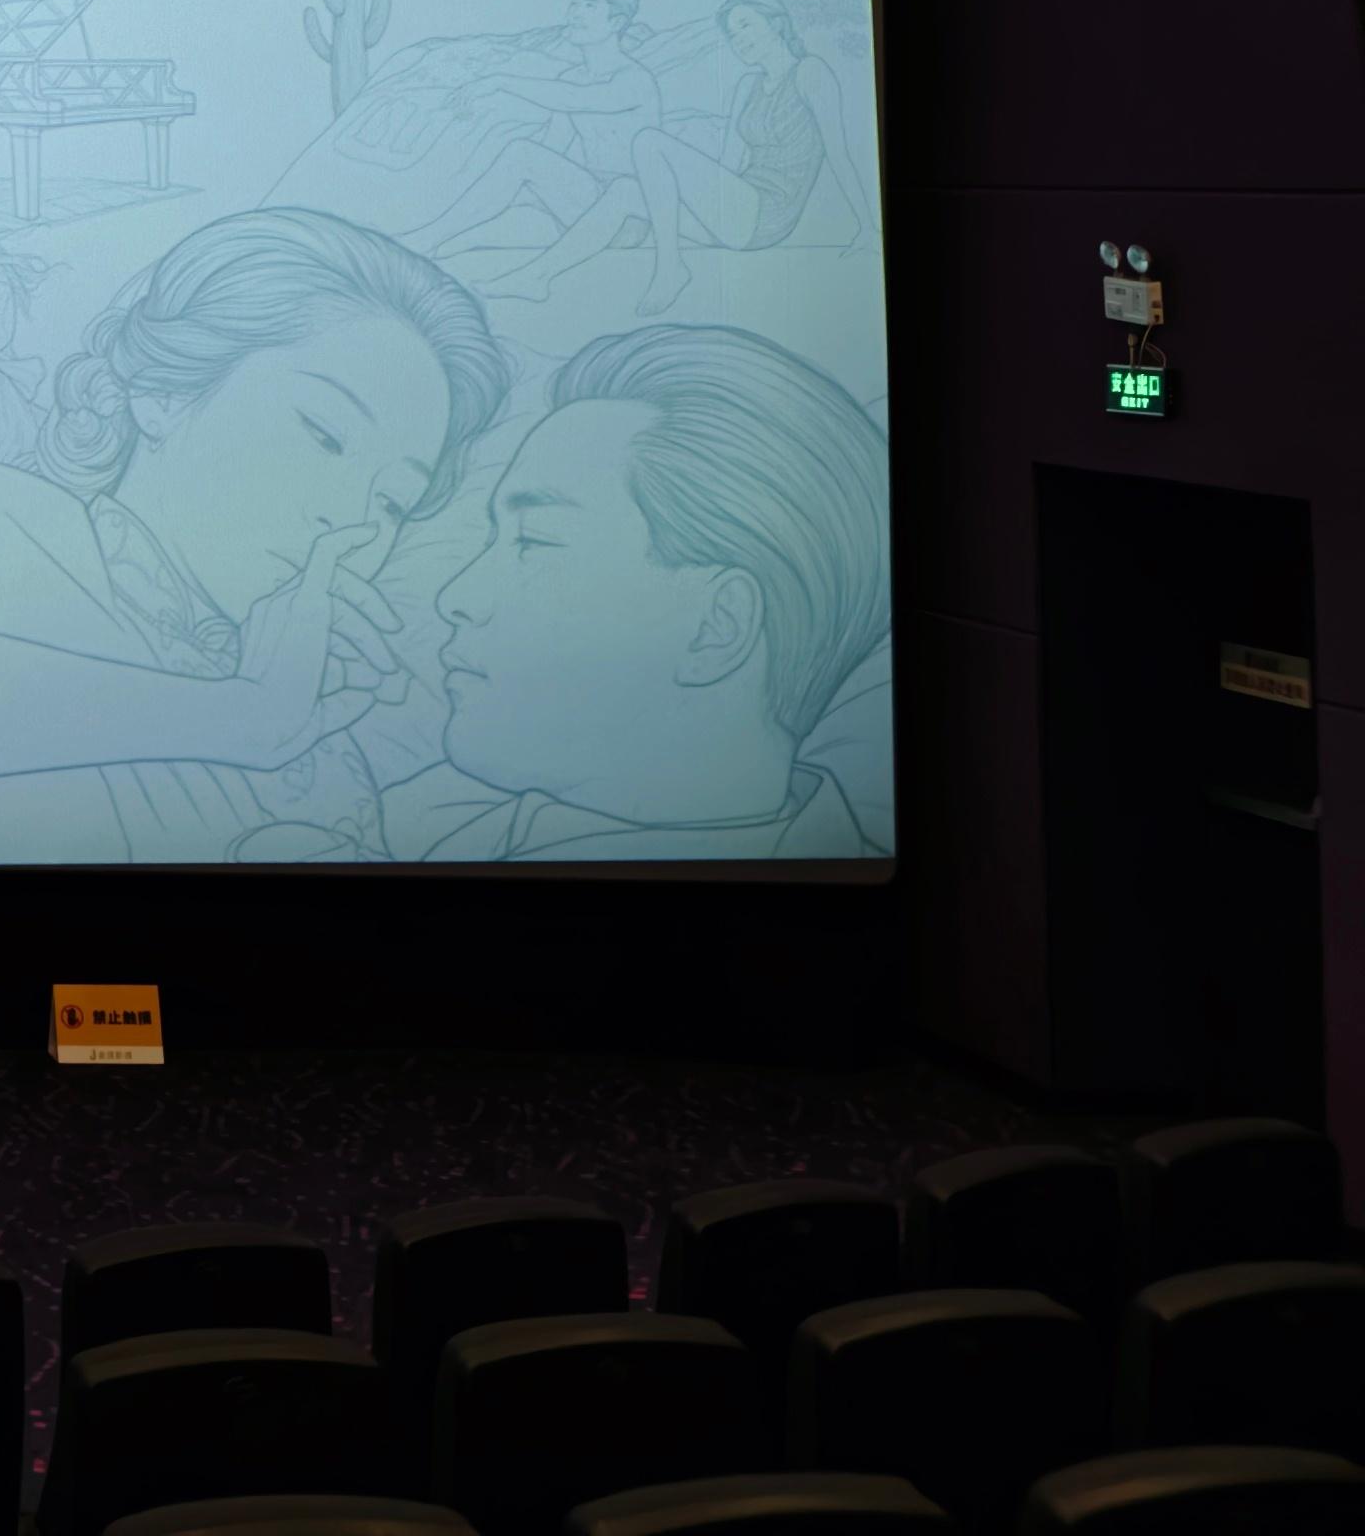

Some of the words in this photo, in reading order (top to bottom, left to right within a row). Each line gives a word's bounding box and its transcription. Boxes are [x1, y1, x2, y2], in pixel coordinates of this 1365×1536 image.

[1111, 372, 1160, 396] 安全出口
[1121, 396, 1149, 408] EXIT
